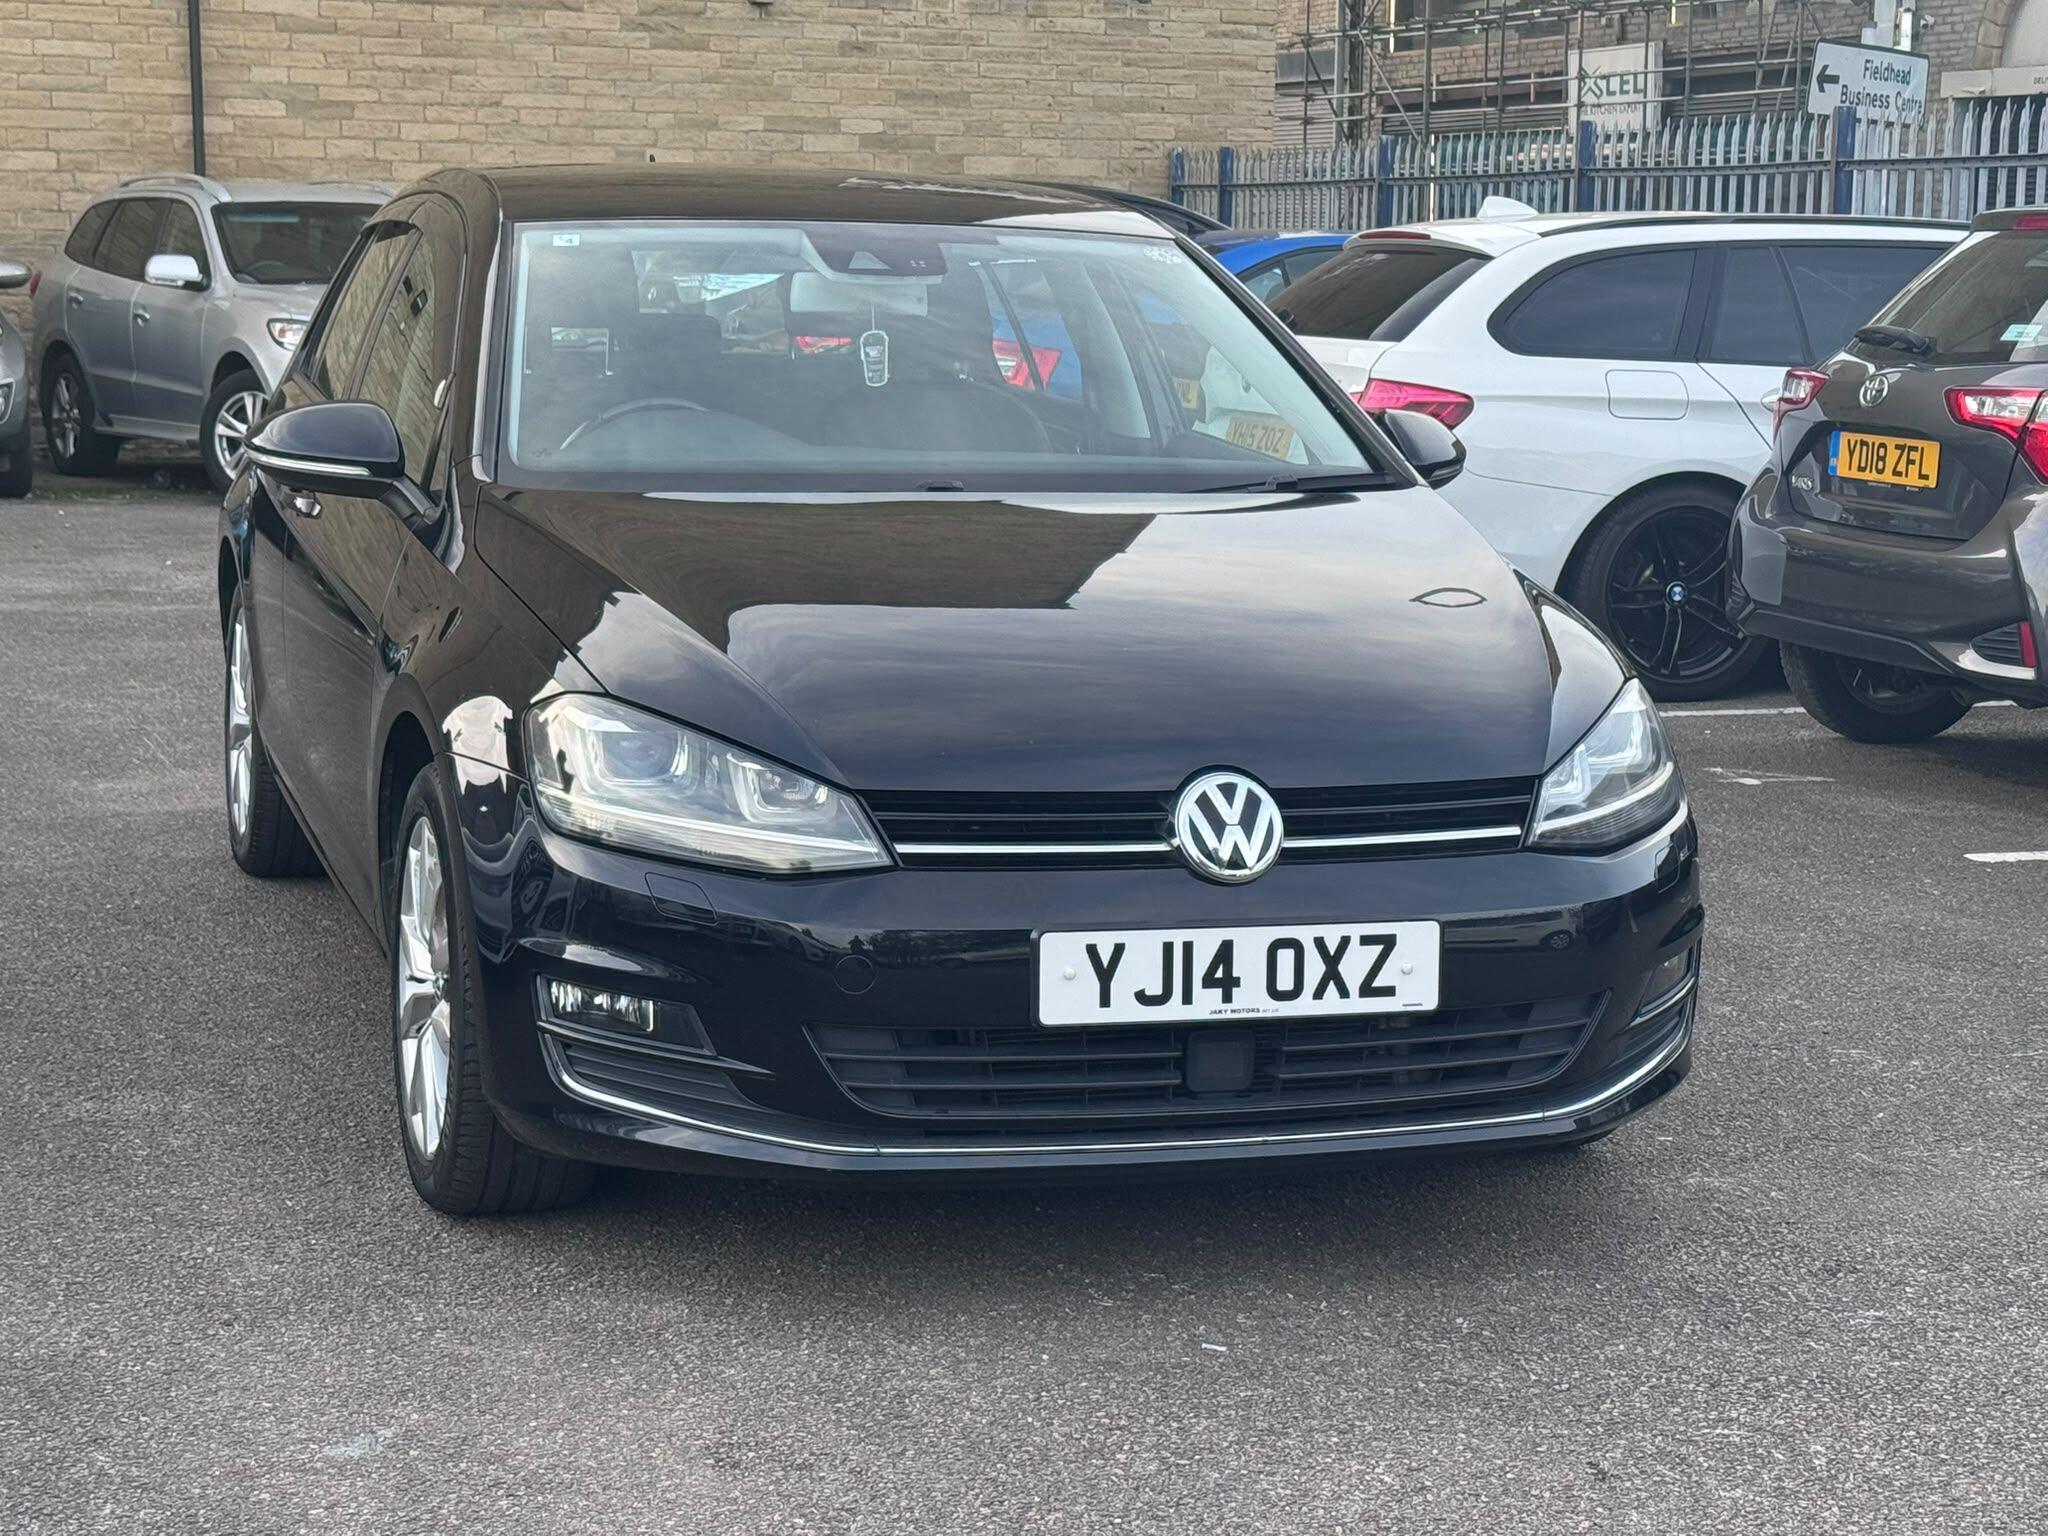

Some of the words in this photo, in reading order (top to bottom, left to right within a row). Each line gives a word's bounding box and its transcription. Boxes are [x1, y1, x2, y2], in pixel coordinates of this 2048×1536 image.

[1863, 59, 1912, 86] Fieldhead
[1840, 84, 1891, 109] Business
[1894, 90, 1923, 114] Centre
[1847, 438, 1888, 475] YD18
[1891, 443, 1930, 481] ZFL
[1085, 939, 1241, 1009] YJ14
[1266, 933, 1398, 1002] OXZ
[1230, 1007, 1261, 1015] MOTORS
